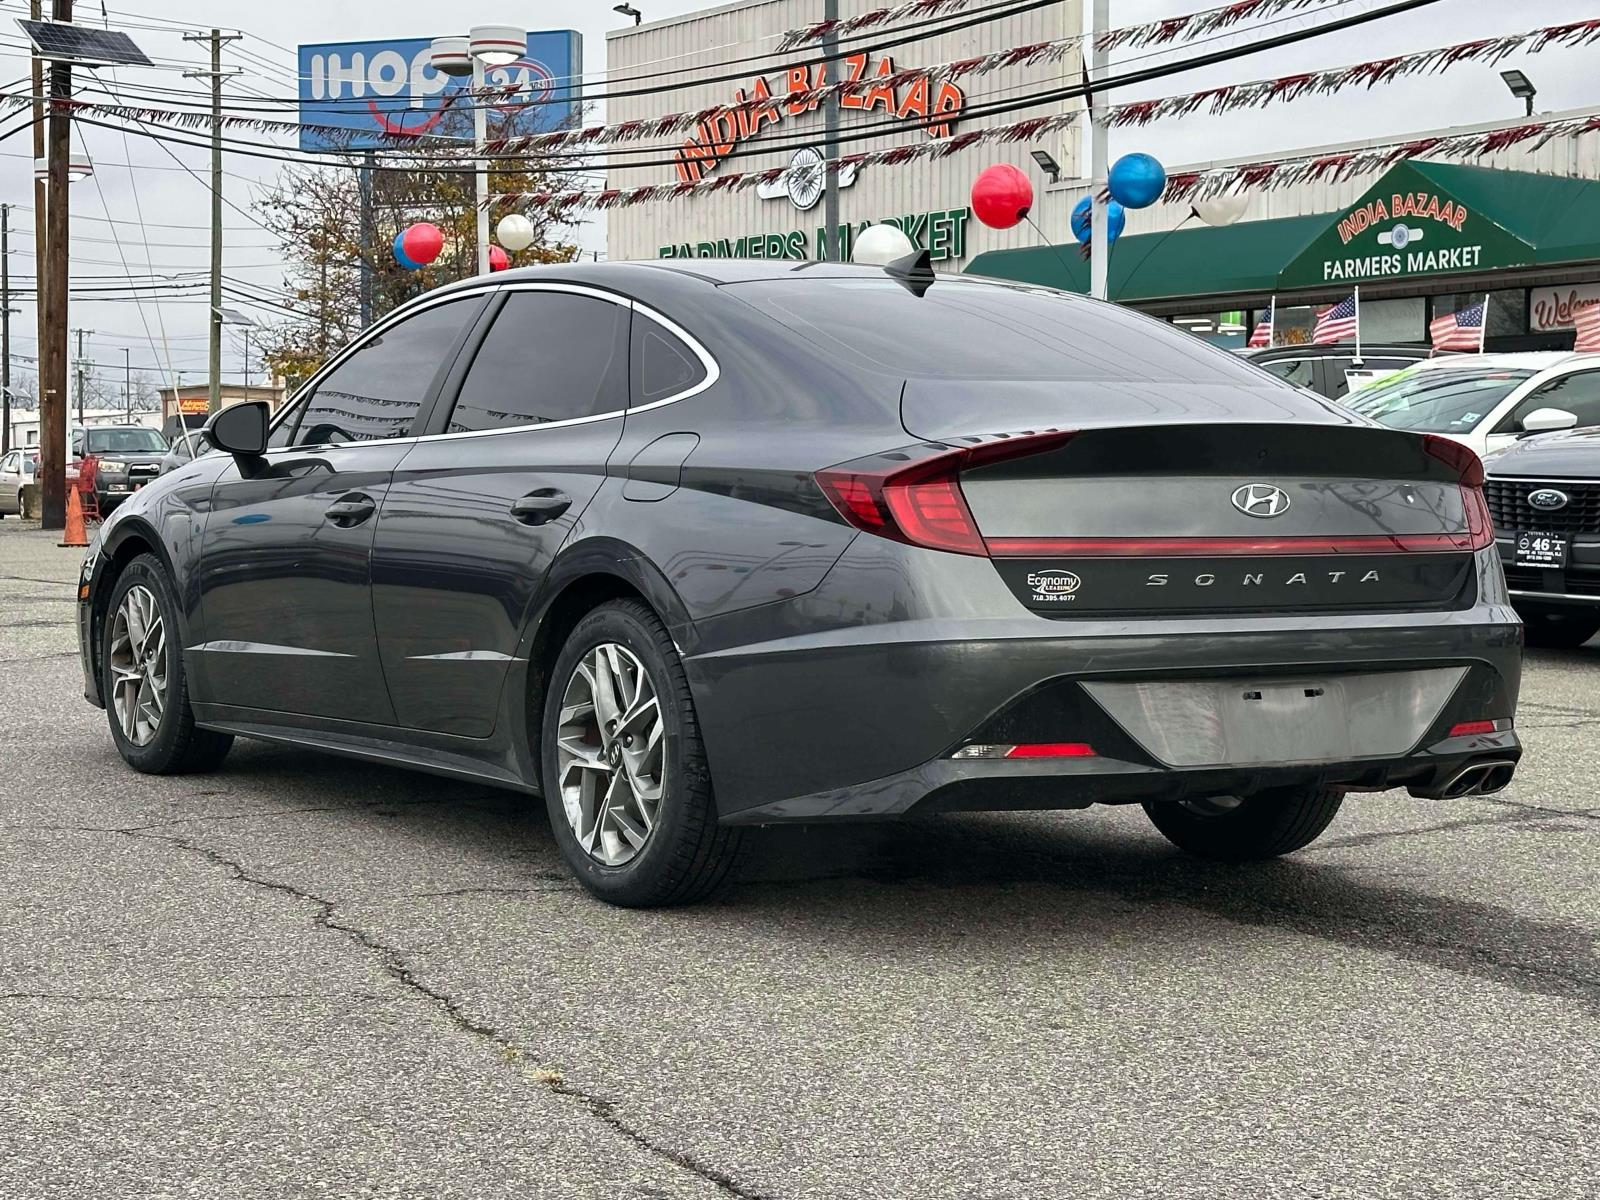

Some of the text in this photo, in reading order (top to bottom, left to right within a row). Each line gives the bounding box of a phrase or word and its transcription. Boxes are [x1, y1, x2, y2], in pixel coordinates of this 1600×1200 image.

[311, 48, 450, 110] IHOP
[491, 67, 531, 103] 24
[673, 76, 780, 183] INDIA
[815, 206, 970, 263] MKET
[1337, 192, 1467, 245] INDIA BAZAAR
[1323, 246, 1482, 280] FARMERS MARKET
[1532, 537, 1550, 551] 46
[1027, 573, 1077, 588] Economy
[1146, 570, 1380, 586] SONATA
